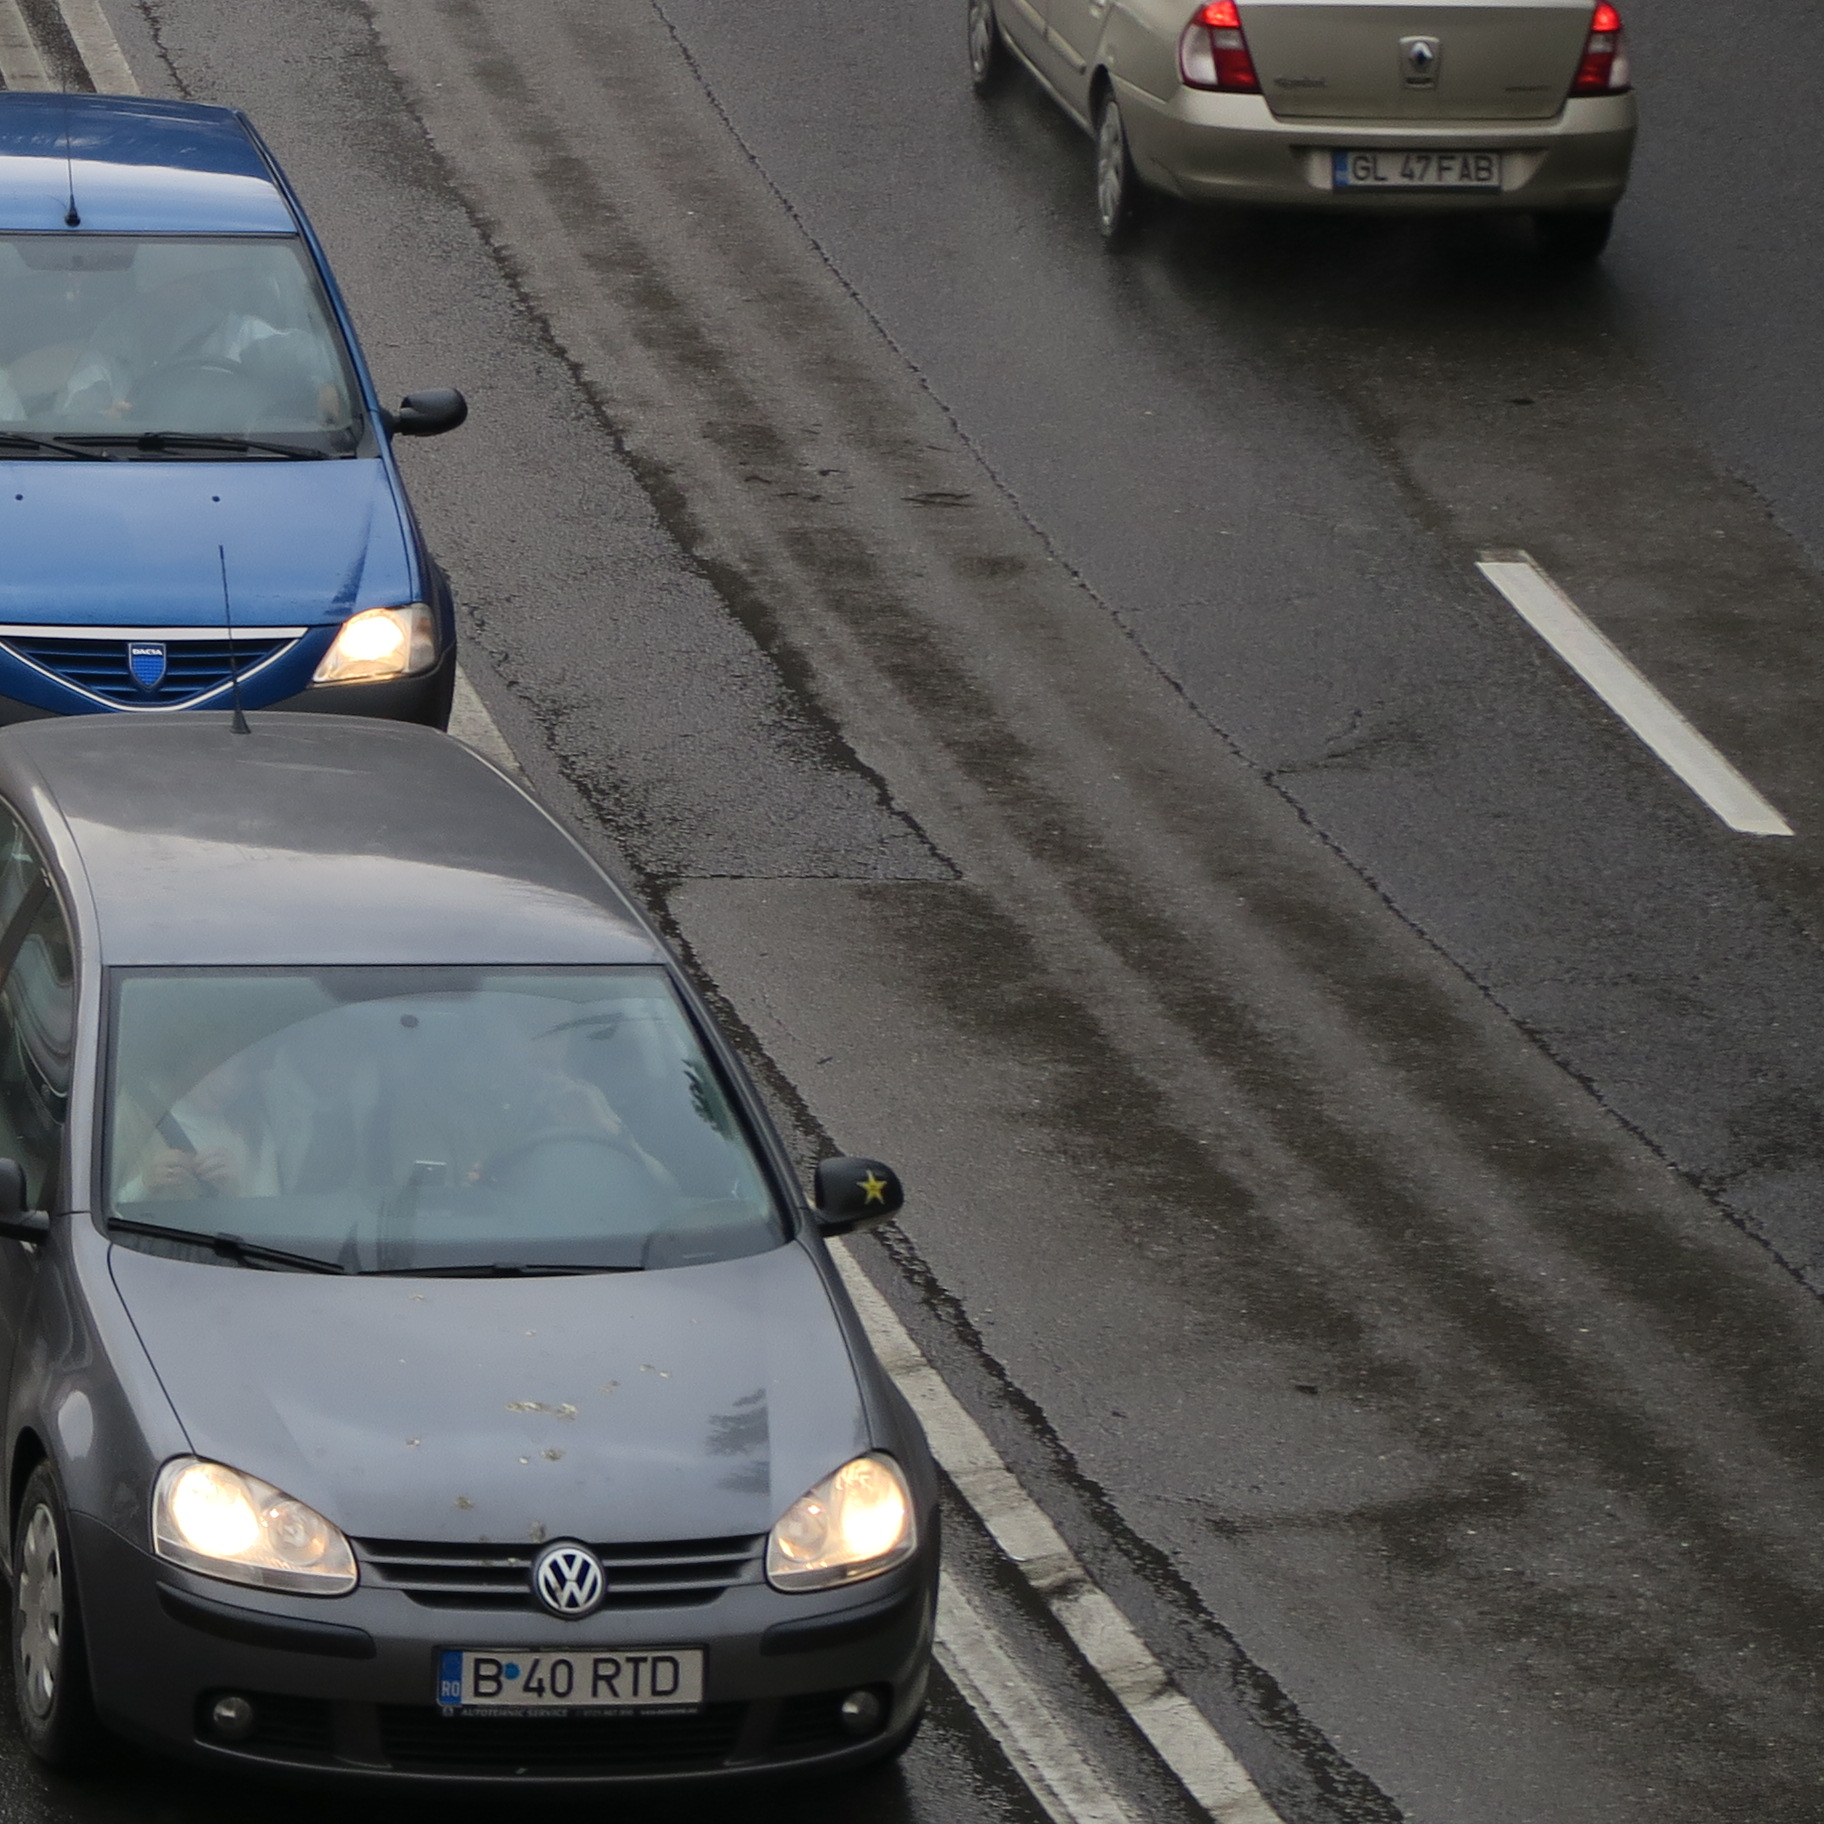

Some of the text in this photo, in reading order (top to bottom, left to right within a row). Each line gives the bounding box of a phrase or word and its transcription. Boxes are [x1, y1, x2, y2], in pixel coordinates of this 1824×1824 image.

[1353, 155, 1388, 182] GL
[132, 648, 163, 656] DACIA
[441, 1655, 681, 1698] RO B 40 RTD
